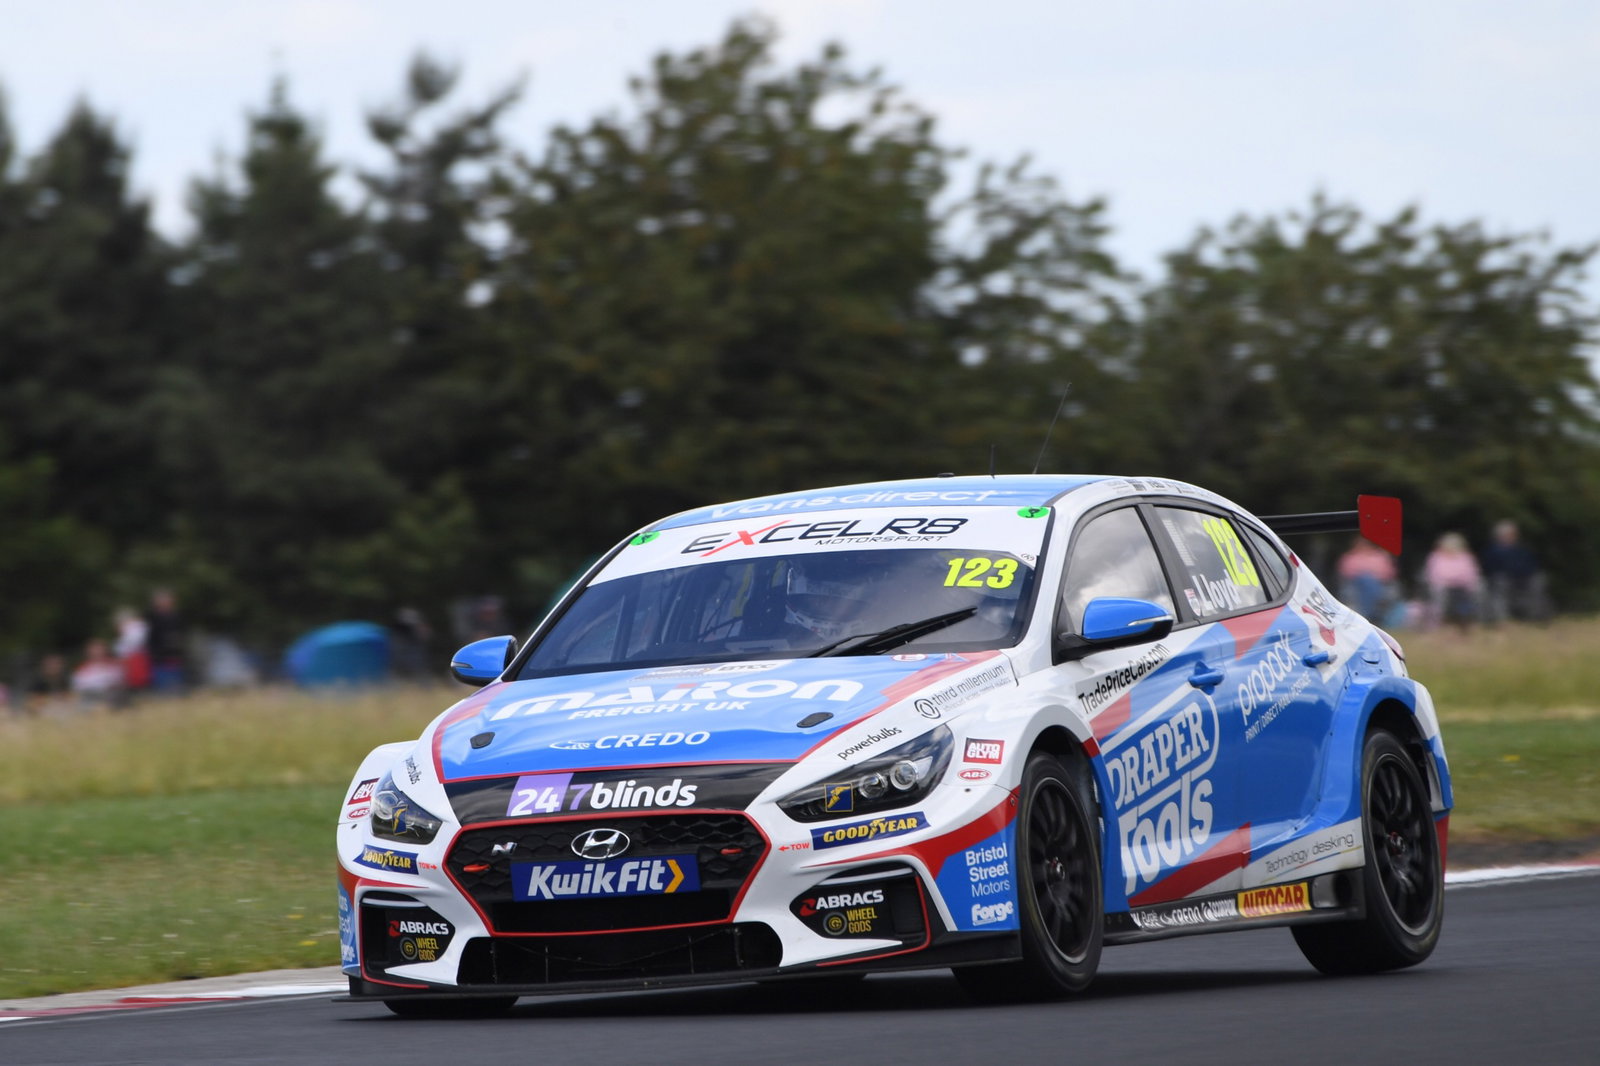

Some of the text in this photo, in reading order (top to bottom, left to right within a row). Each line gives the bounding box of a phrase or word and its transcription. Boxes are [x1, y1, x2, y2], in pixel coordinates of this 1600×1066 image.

[680, 517, 968, 557] EXCELR8
[815, 535, 947, 547] MOTORSPORT
[1202, 518, 1259, 587] 123
[943, 557, 1019, 589] 123
[932, 686, 958, 706] third
[957, 665, 1006, 693] millennium
[1078, 643, 1170, 714] TradePriceCars.com
[1238, 629, 1301, 727] propack
[568, 700, 753, 720] FREIGHT UK
[595, 731, 711, 750] CREDO
[837, 726, 903, 761] powerbulbs
[968, 742, 1001, 752] AUTO
[1105, 702, 1210, 811] DRAPER
[823, 815, 918, 843] GOODYEAR
[1117, 771, 1214, 897] Tools
[791, 842, 810, 851] TOW
[965, 842, 1008, 866] Bristol
[1265, 834, 1354, 873] Technology desking
[969, 861, 1009, 883] Street
[816, 889, 885, 910] ABRACS
[971, 879, 1011, 898] Motors
[1243, 885, 1305, 915] AUTOCAR
[846, 907, 877, 921] WHEEL
[399, 921, 449, 935] ABRACS
[848, 920, 872, 934] GODS
[416, 937, 439, 950] WHEEL
[418, 949, 436, 960] GODS
